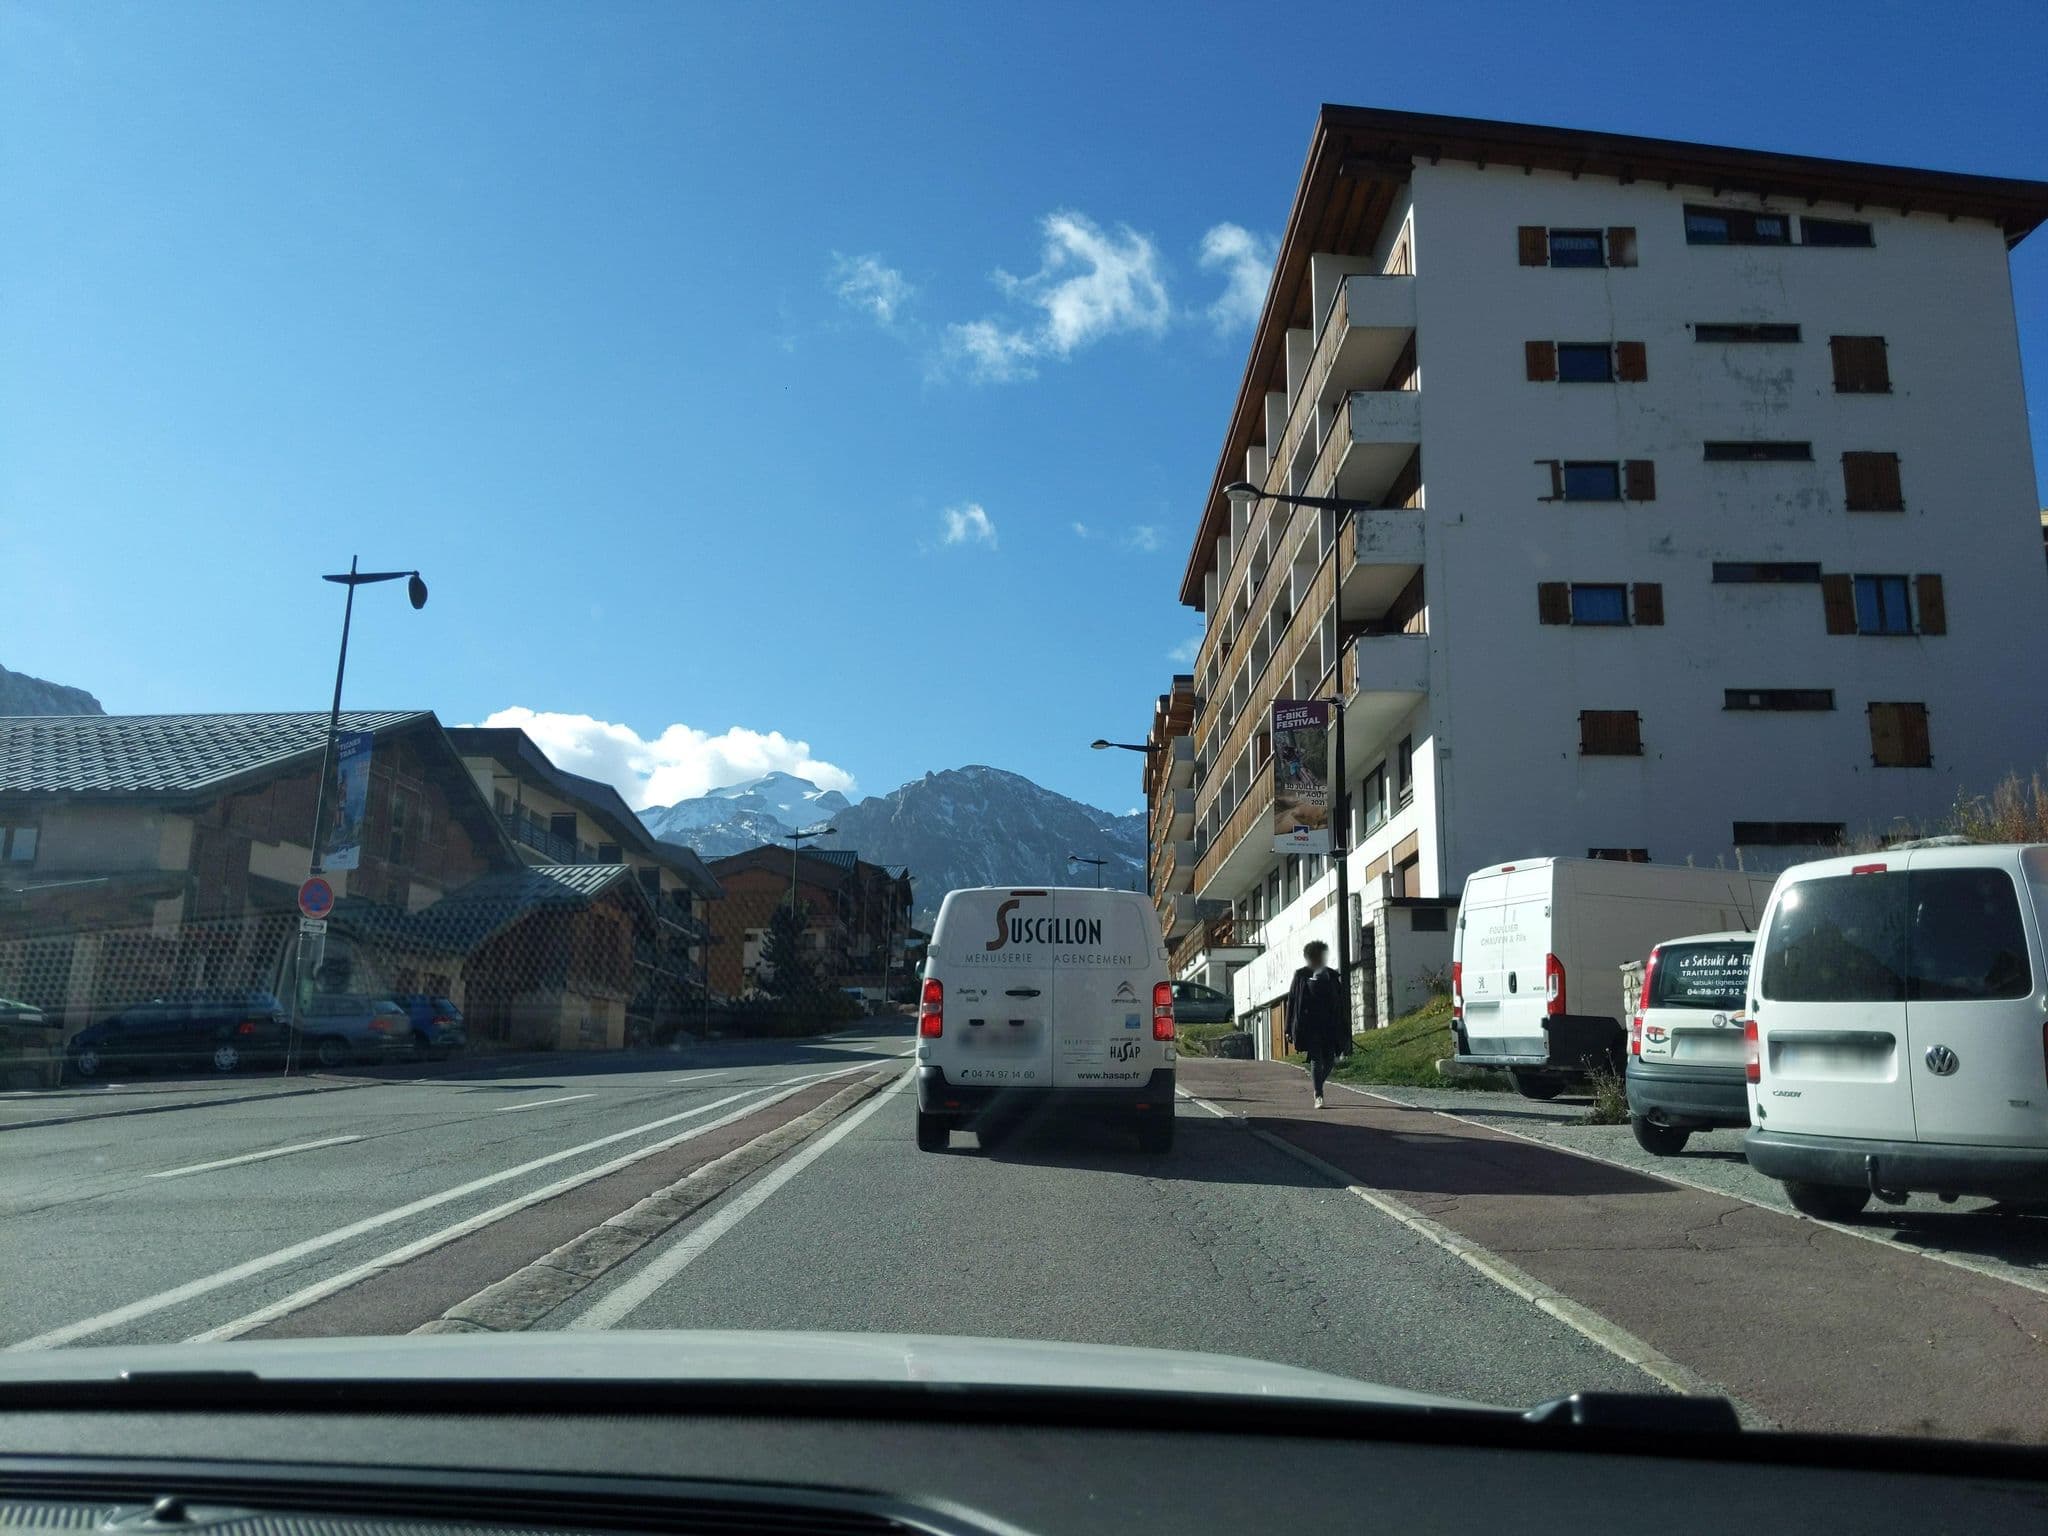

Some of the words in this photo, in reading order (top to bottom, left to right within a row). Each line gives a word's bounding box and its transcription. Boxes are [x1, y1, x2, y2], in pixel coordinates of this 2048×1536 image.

[1277, 711, 1307, 721] E-BIKE
[1277, 717, 1320, 729] FESTIVAL
[965, 953, 1032, 963] MENUISERIE
[1054, 954, 1132, 965] AGENCEMENT
[1693, 954, 1725, 967] Satsuki
[1727, 954, 1738, 966] de
[1078, 1072, 1140, 1080] www.hasap.fr
[1773, 1090, 1801, 1098] CADDY
